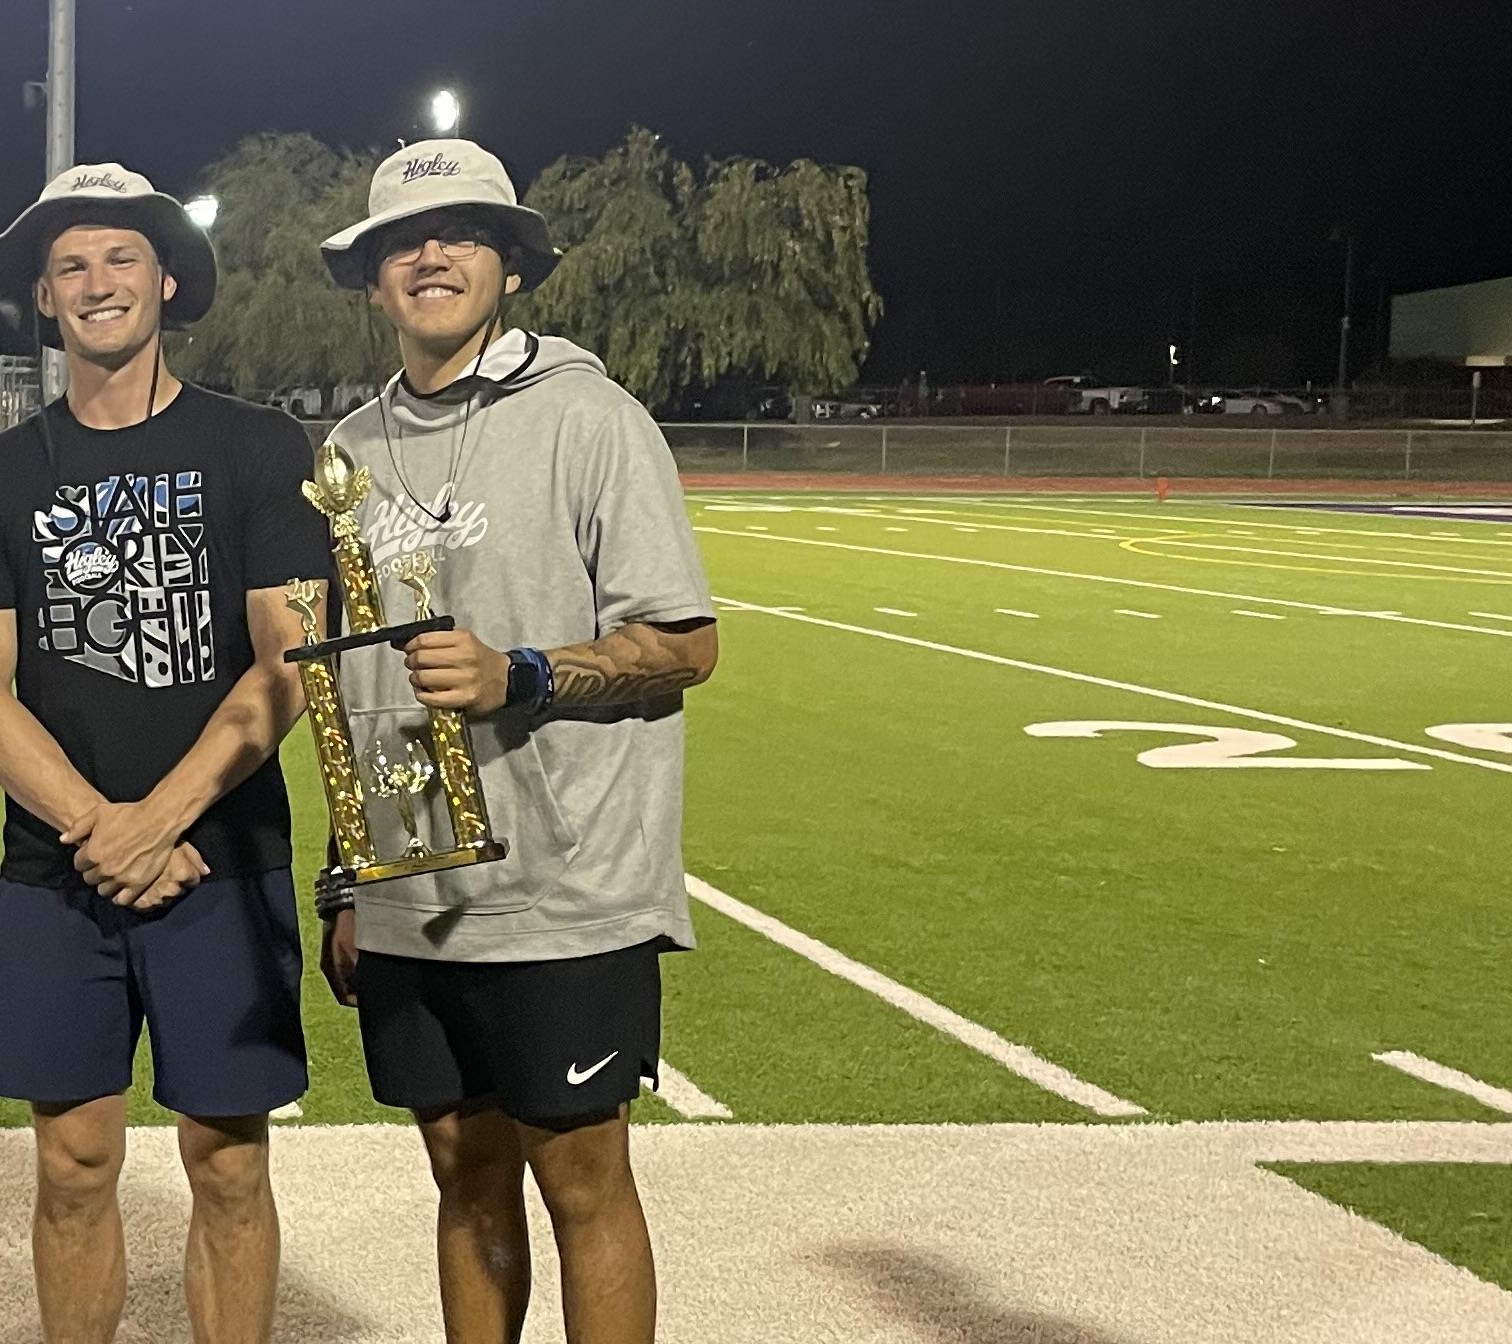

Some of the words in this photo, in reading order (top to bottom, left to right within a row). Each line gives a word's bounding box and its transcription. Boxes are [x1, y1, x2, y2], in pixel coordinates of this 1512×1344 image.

[402, 153, 461, 184] Higley
[367, 481, 488, 564] Higley
[1023, 719, 1512, 769] 2
